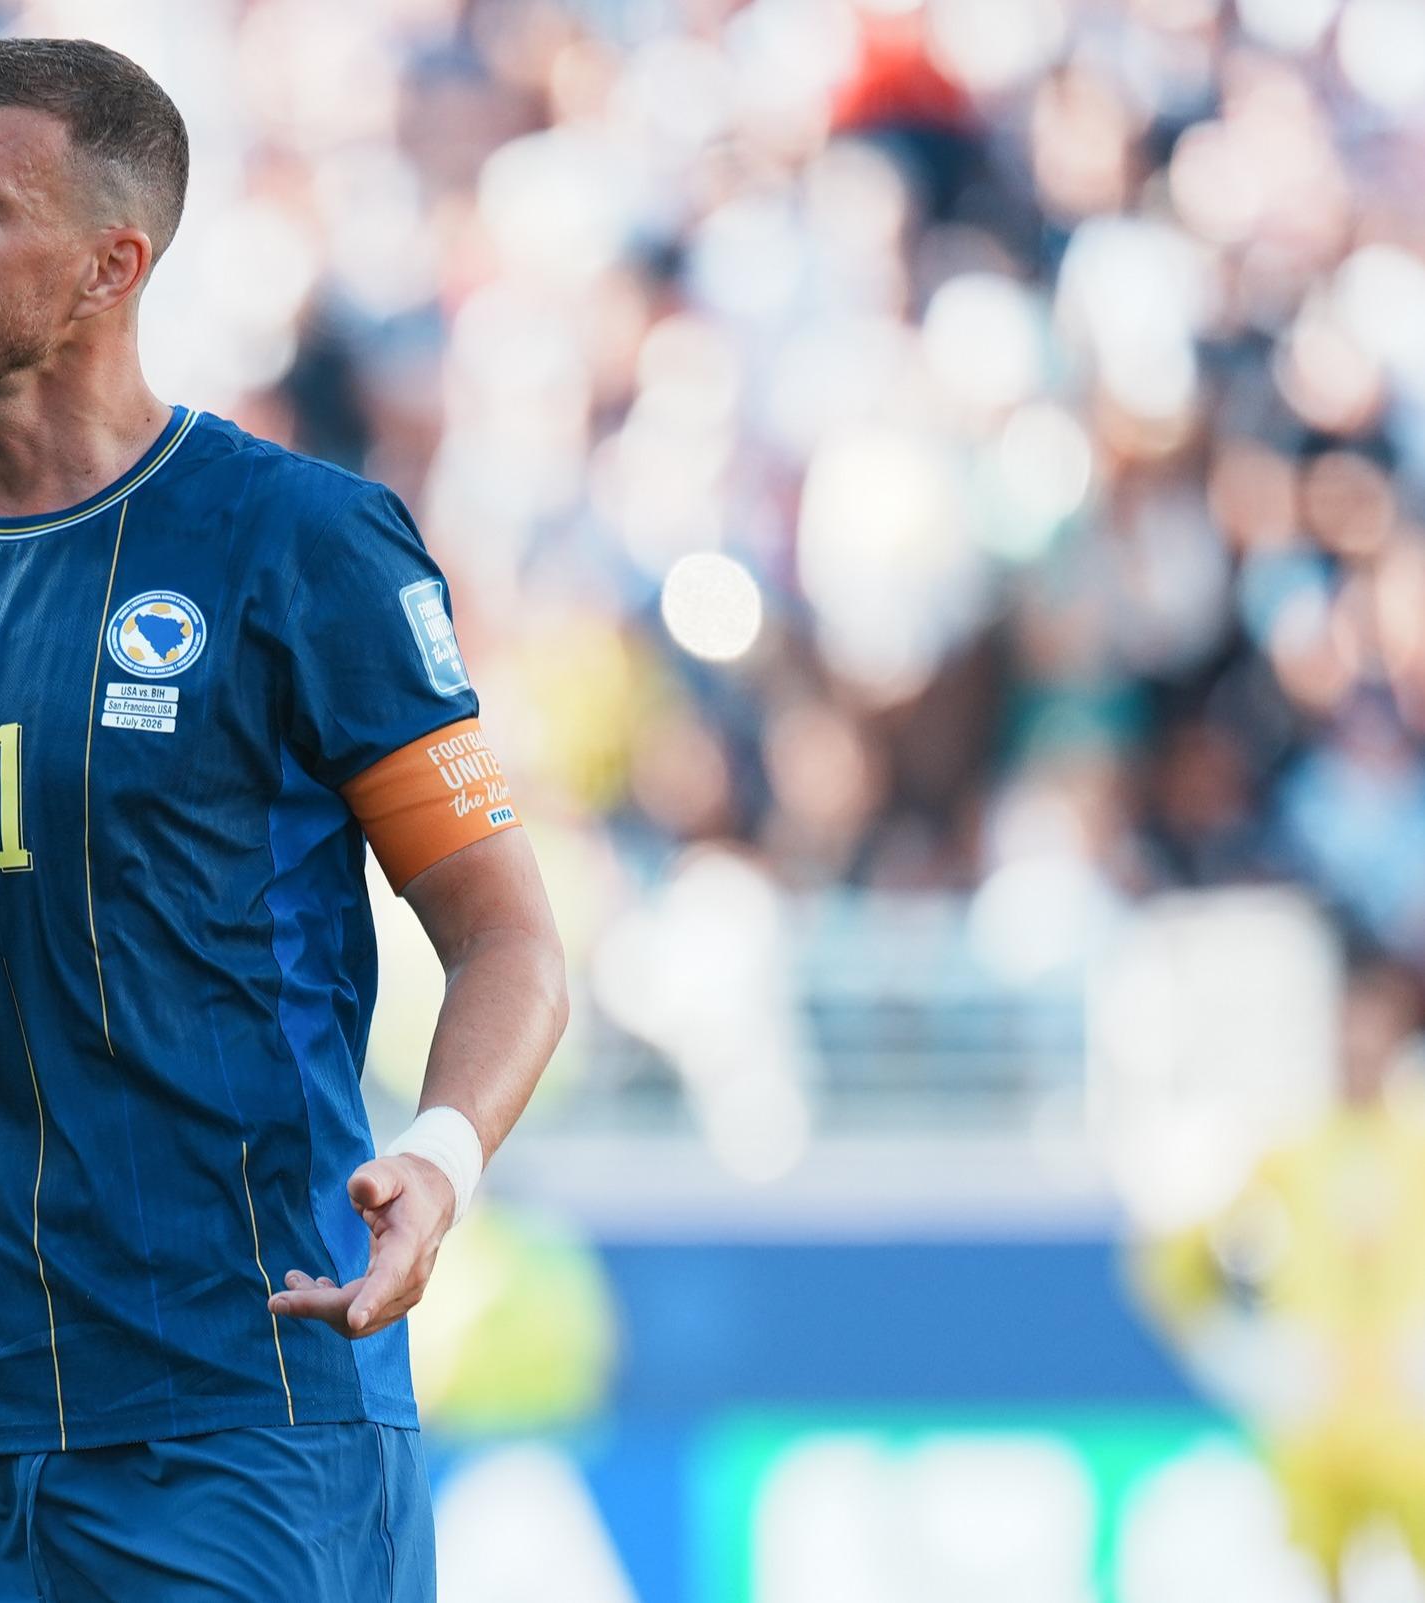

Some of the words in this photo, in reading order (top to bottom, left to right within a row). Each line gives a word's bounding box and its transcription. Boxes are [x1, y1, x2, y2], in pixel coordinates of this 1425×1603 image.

[120, 686, 137, 697] USA
[139, 689, 150, 697] vs.
[151, 688, 165, 699] BIH
[108, 700, 122, 710] San
[116, 716, 120, 725] 1
[121, 716, 139, 729] July
[140, 718, 163, 729] 2026
[438, 750, 502, 790] UNITE
[448, 788, 485, 818] the
[490, 808, 513, 824] FIFA
